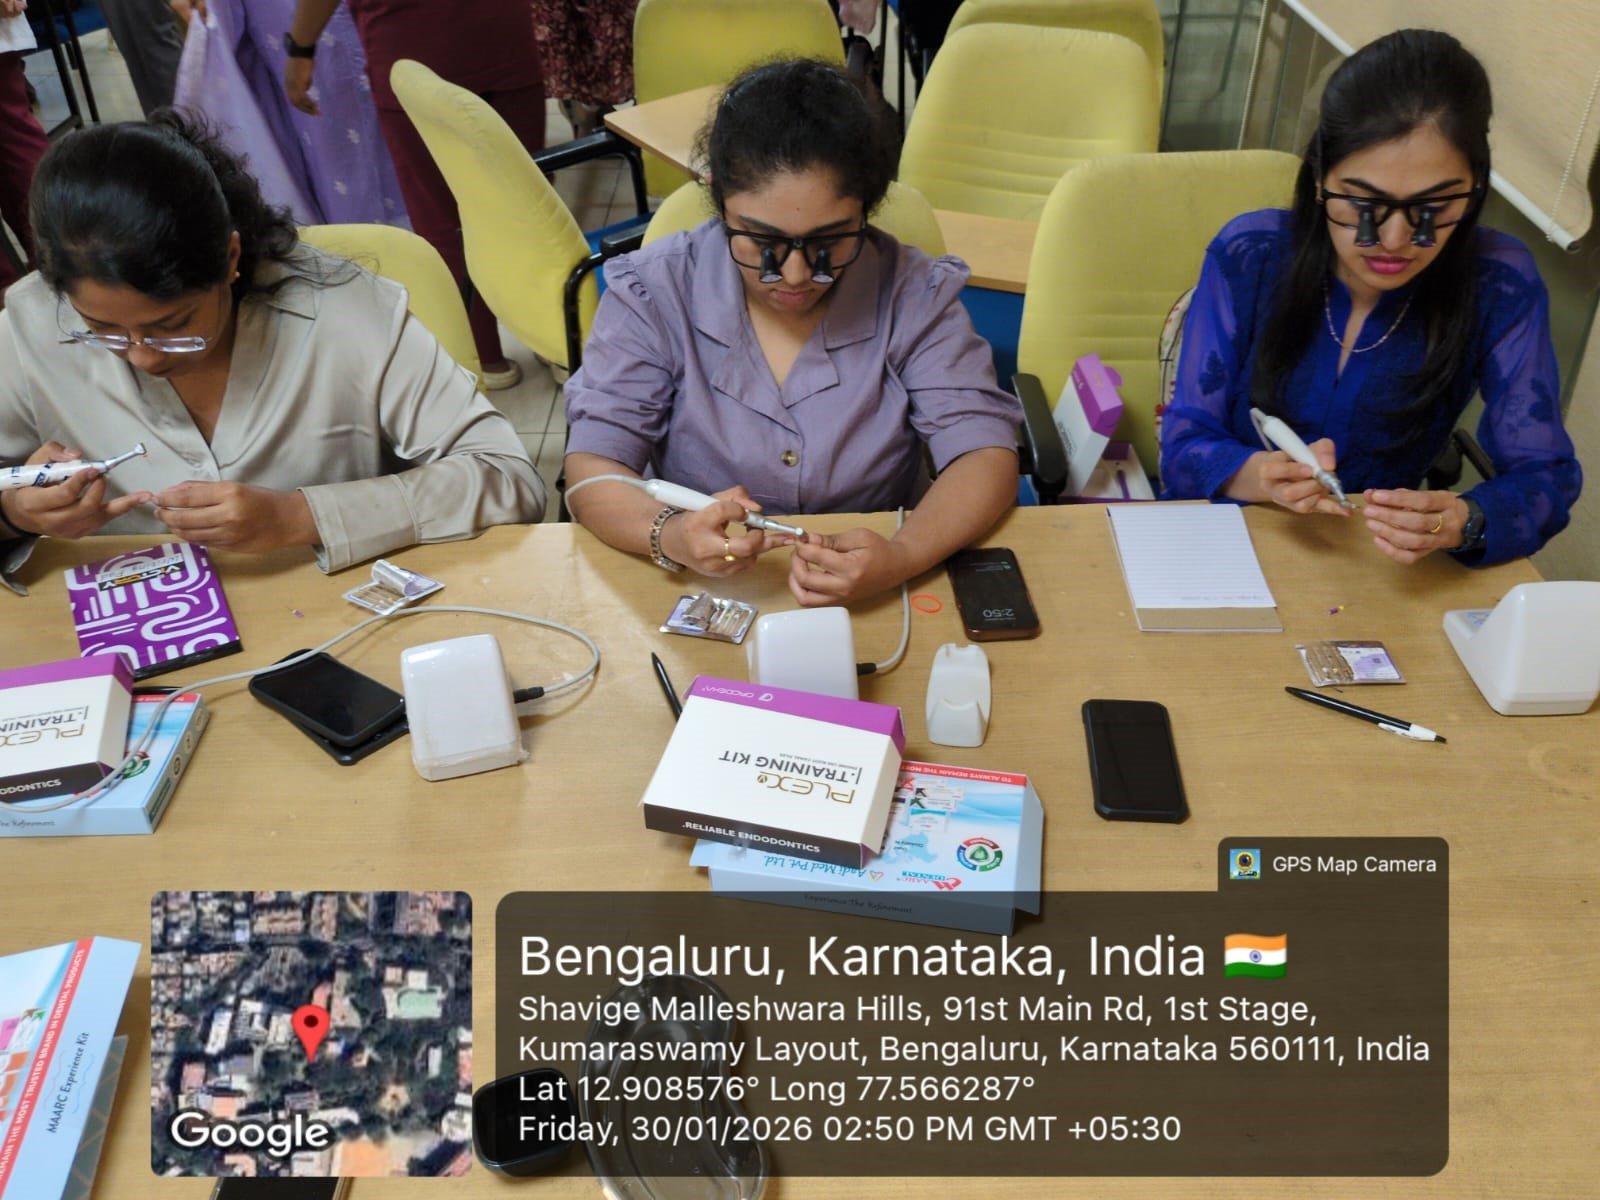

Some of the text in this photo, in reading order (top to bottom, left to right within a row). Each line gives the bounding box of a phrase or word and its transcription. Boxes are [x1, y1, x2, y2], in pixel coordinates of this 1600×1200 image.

[982, 608, 1015, 618] 2:50
[718, 750, 751, 765] KIT
[940, 770, 969, 778] REMAIN
[760, 771, 855, 804] PLEX
[738, 831, 821, 853] ENDODONTICS
[764, 855, 785, 867] Ltd.
[809, 862, 836, 874] Med
[64, 949, 85, 989] PRODUCTS
[53, 989, 71, 1019] DENTAL
[49, 1020, 59, 1030] IN
[38, 1030, 55, 1059] BRAND
[24, 1060, 44, 1098] TRUSTED
[46, 1032, 90, 1133] MAARC Experience Kit
[16, 1100, 30, 1124] MOST
[9, 1126, 21, 1142] THE
